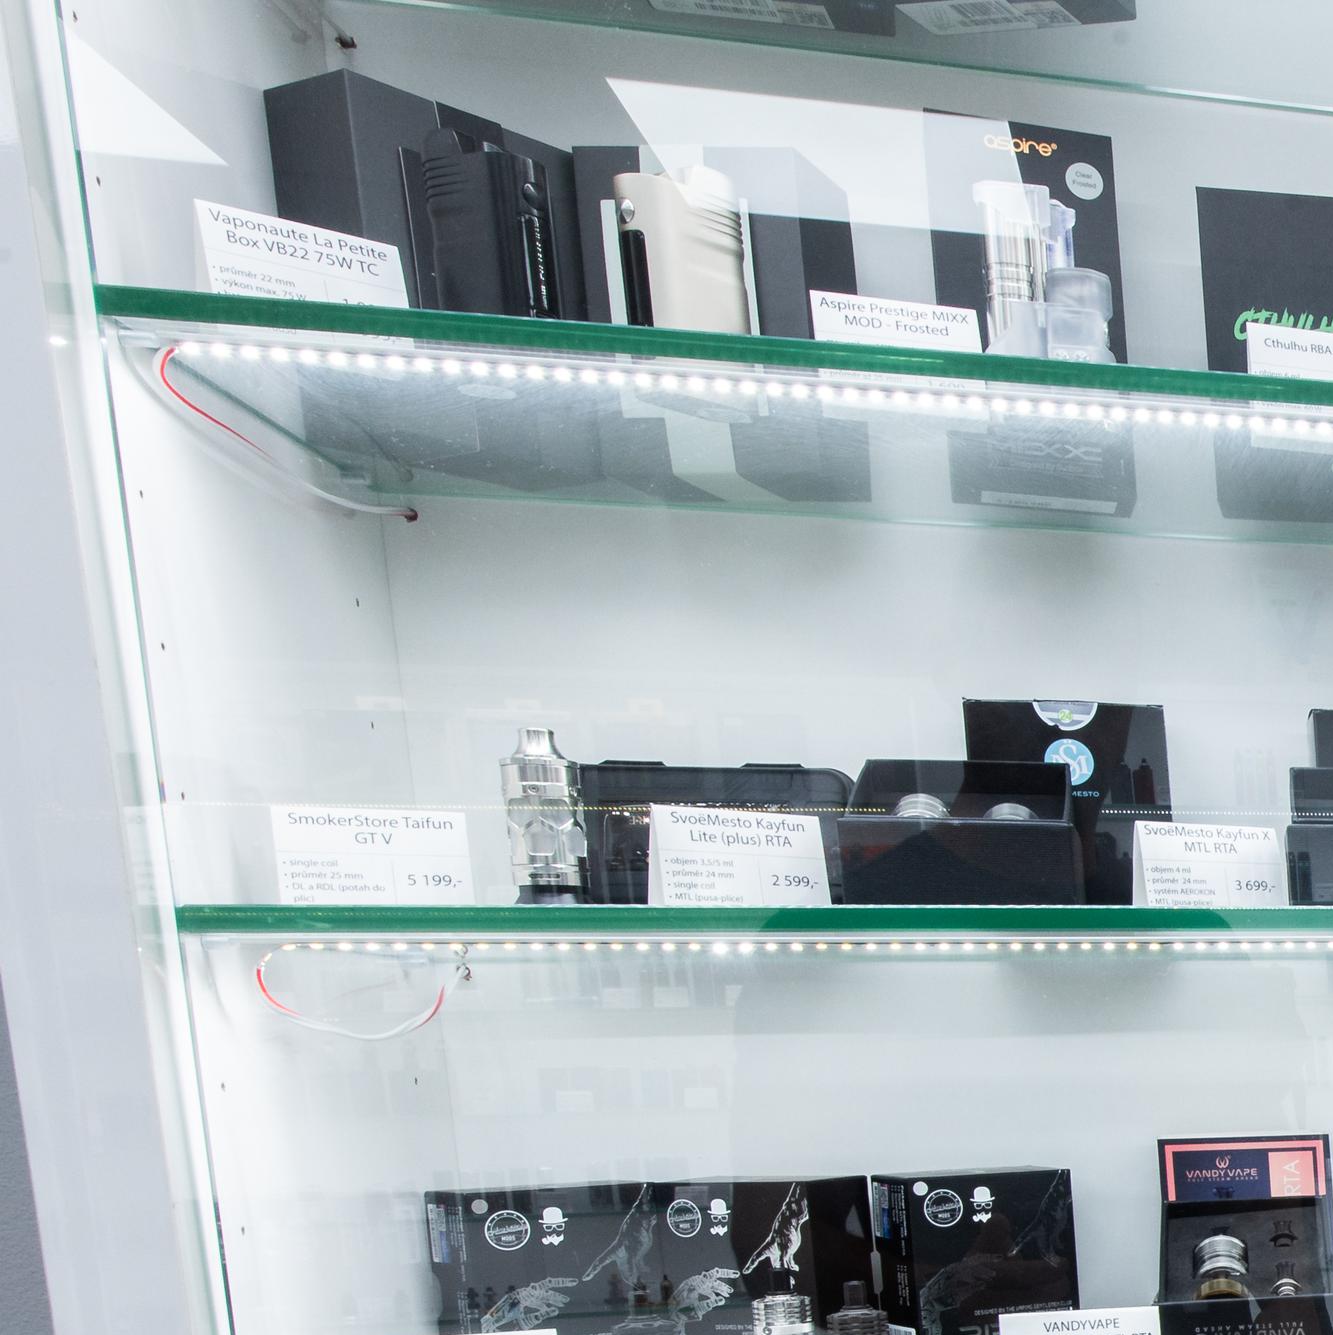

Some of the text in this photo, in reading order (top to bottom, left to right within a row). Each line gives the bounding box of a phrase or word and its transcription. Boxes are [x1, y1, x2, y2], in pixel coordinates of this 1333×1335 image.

[208, 207, 387, 262] Vaponaute La Petite
[226, 230, 379, 276] Box VB22 75W TC
[820, 297, 968, 324] Aspire Prestige MIXX
[844, 315, 882, 329] MOD
[896, 321, 949, 337] Frosted
[1264, 338, 1307, 352] Cthulhu
[1311, 344, 1332, 355] RBA
[288, 811, 454, 830] SmokerStore Taifun
[670, 810, 806, 835] SvoëMesto Kayfun
[354, 831, 393, 845] GT V
[690, 830, 792, 848] Lite (plus) RTA
[408, 872, 463, 888] 5 199,-
[772, 874, 819, 890] 2 599,-
[1043, 1317, 1120, 1332] VANDYVAPE
